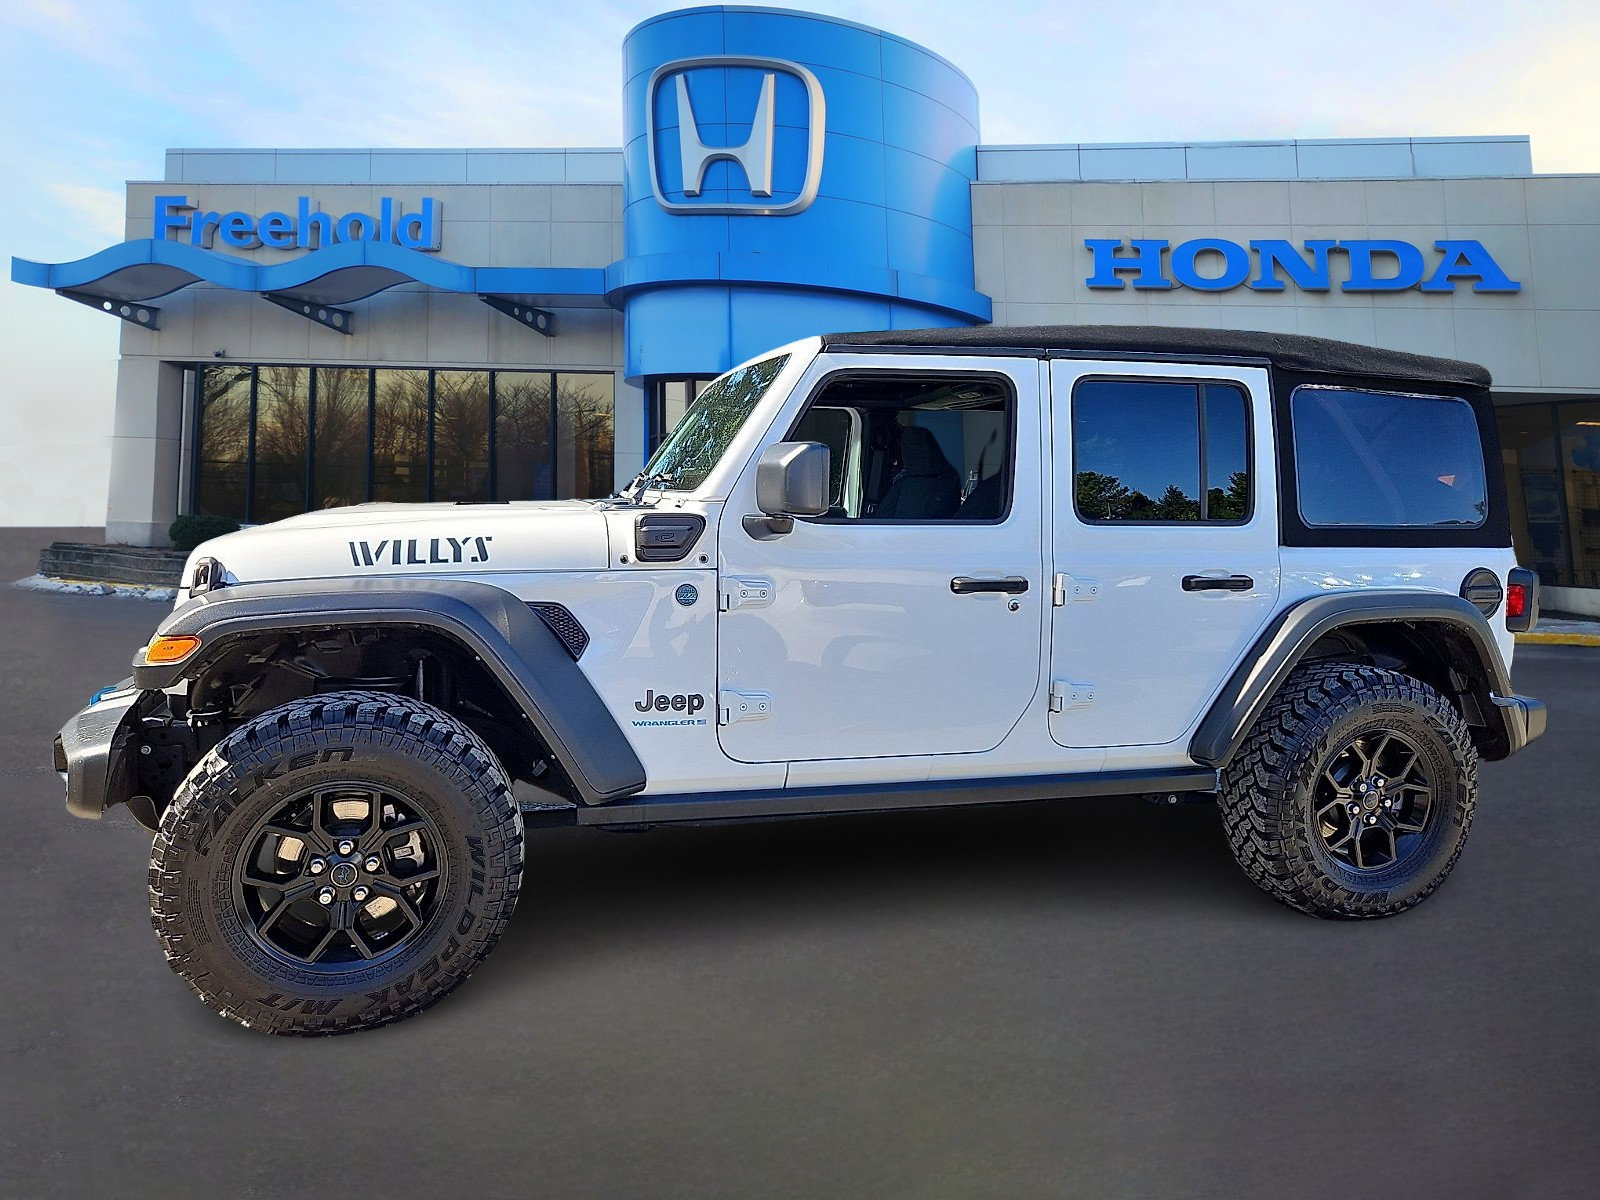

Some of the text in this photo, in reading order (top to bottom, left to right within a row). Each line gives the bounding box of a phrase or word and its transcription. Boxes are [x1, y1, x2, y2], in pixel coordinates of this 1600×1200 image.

[154, 195, 440, 251] Freehold
[1084, 238, 1521, 292] HONDA
[349, 536, 493, 567] WILLYS
[631, 719, 696, 727] WRANGLER
[634, 689, 705, 715] Jeep
[366, 835, 487, 1006] WILDPEAK
